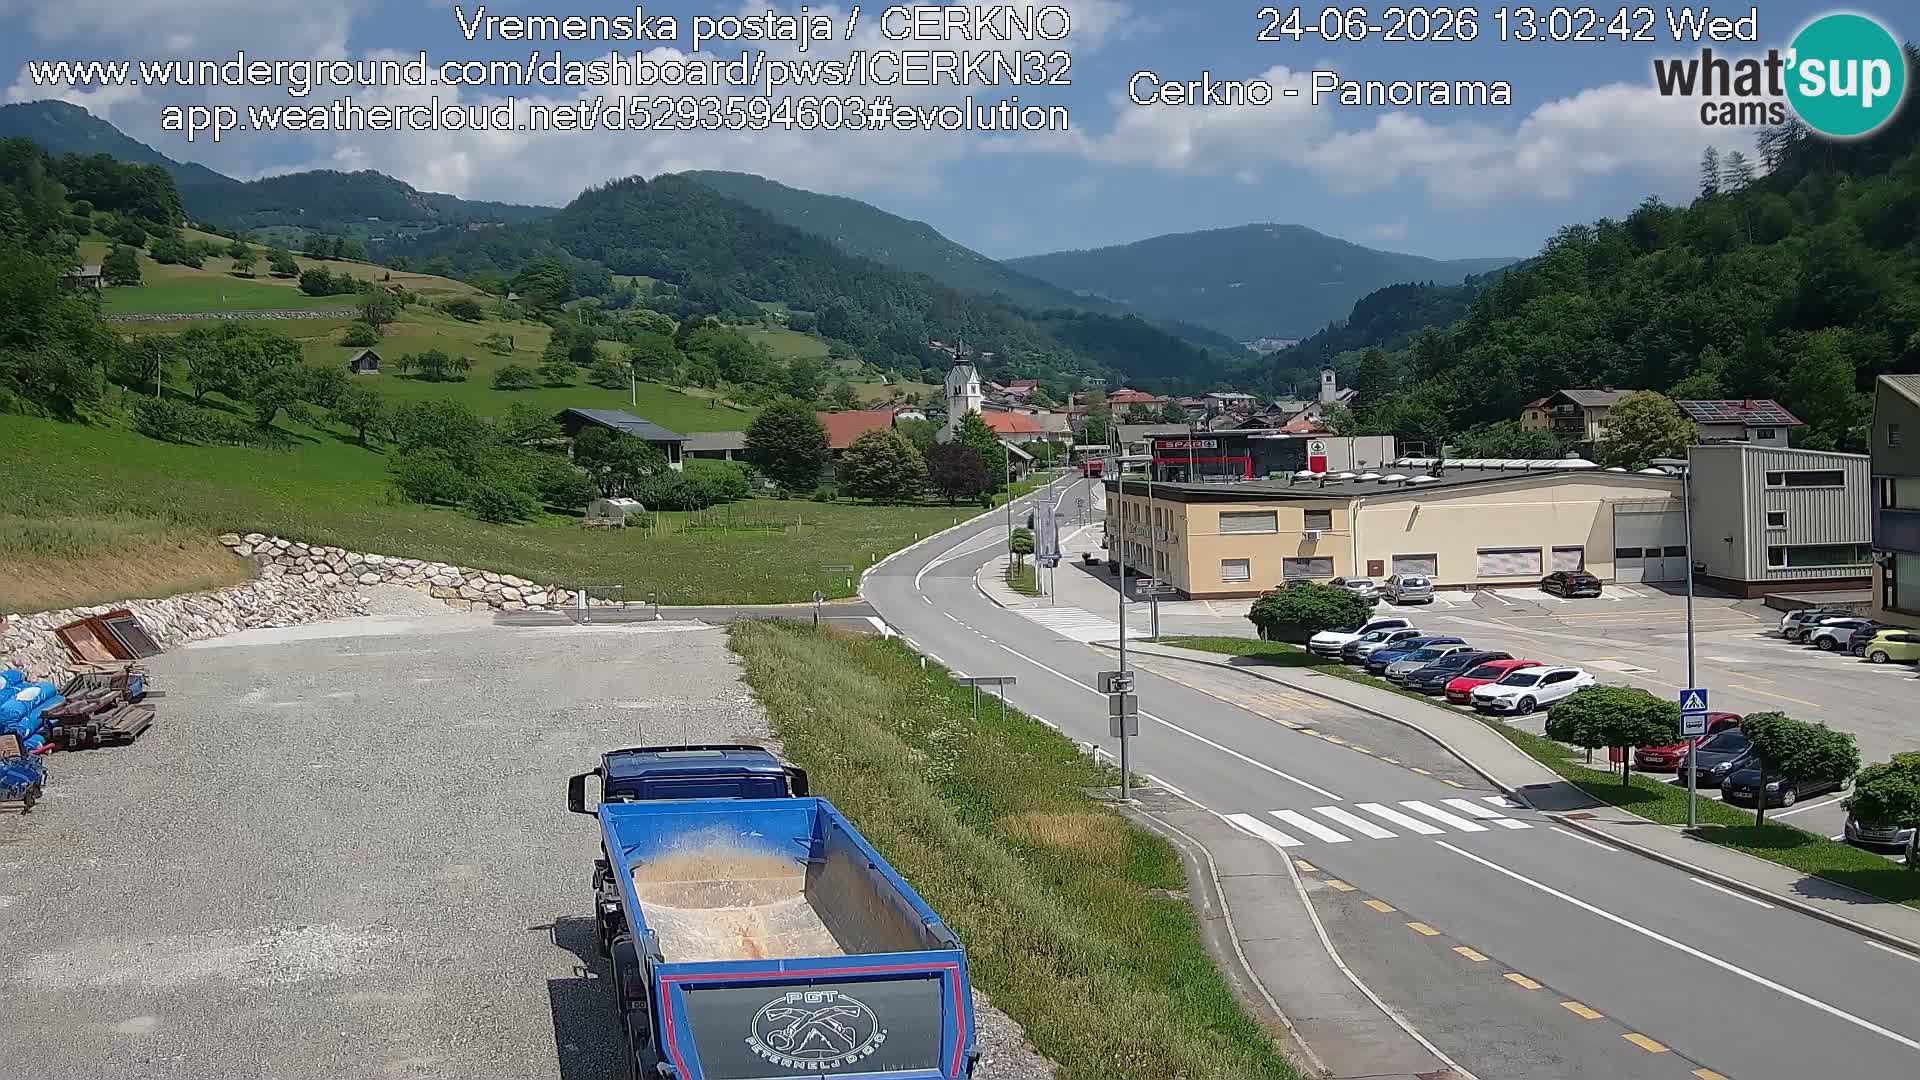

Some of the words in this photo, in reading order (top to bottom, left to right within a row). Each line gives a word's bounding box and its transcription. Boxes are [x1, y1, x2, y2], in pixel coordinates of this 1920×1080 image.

[1165, 441, 1202, 449] SPAR
[785, 990, 839, 1004] PGT
[744, 1035, 842, 1070] PETERNELJ
